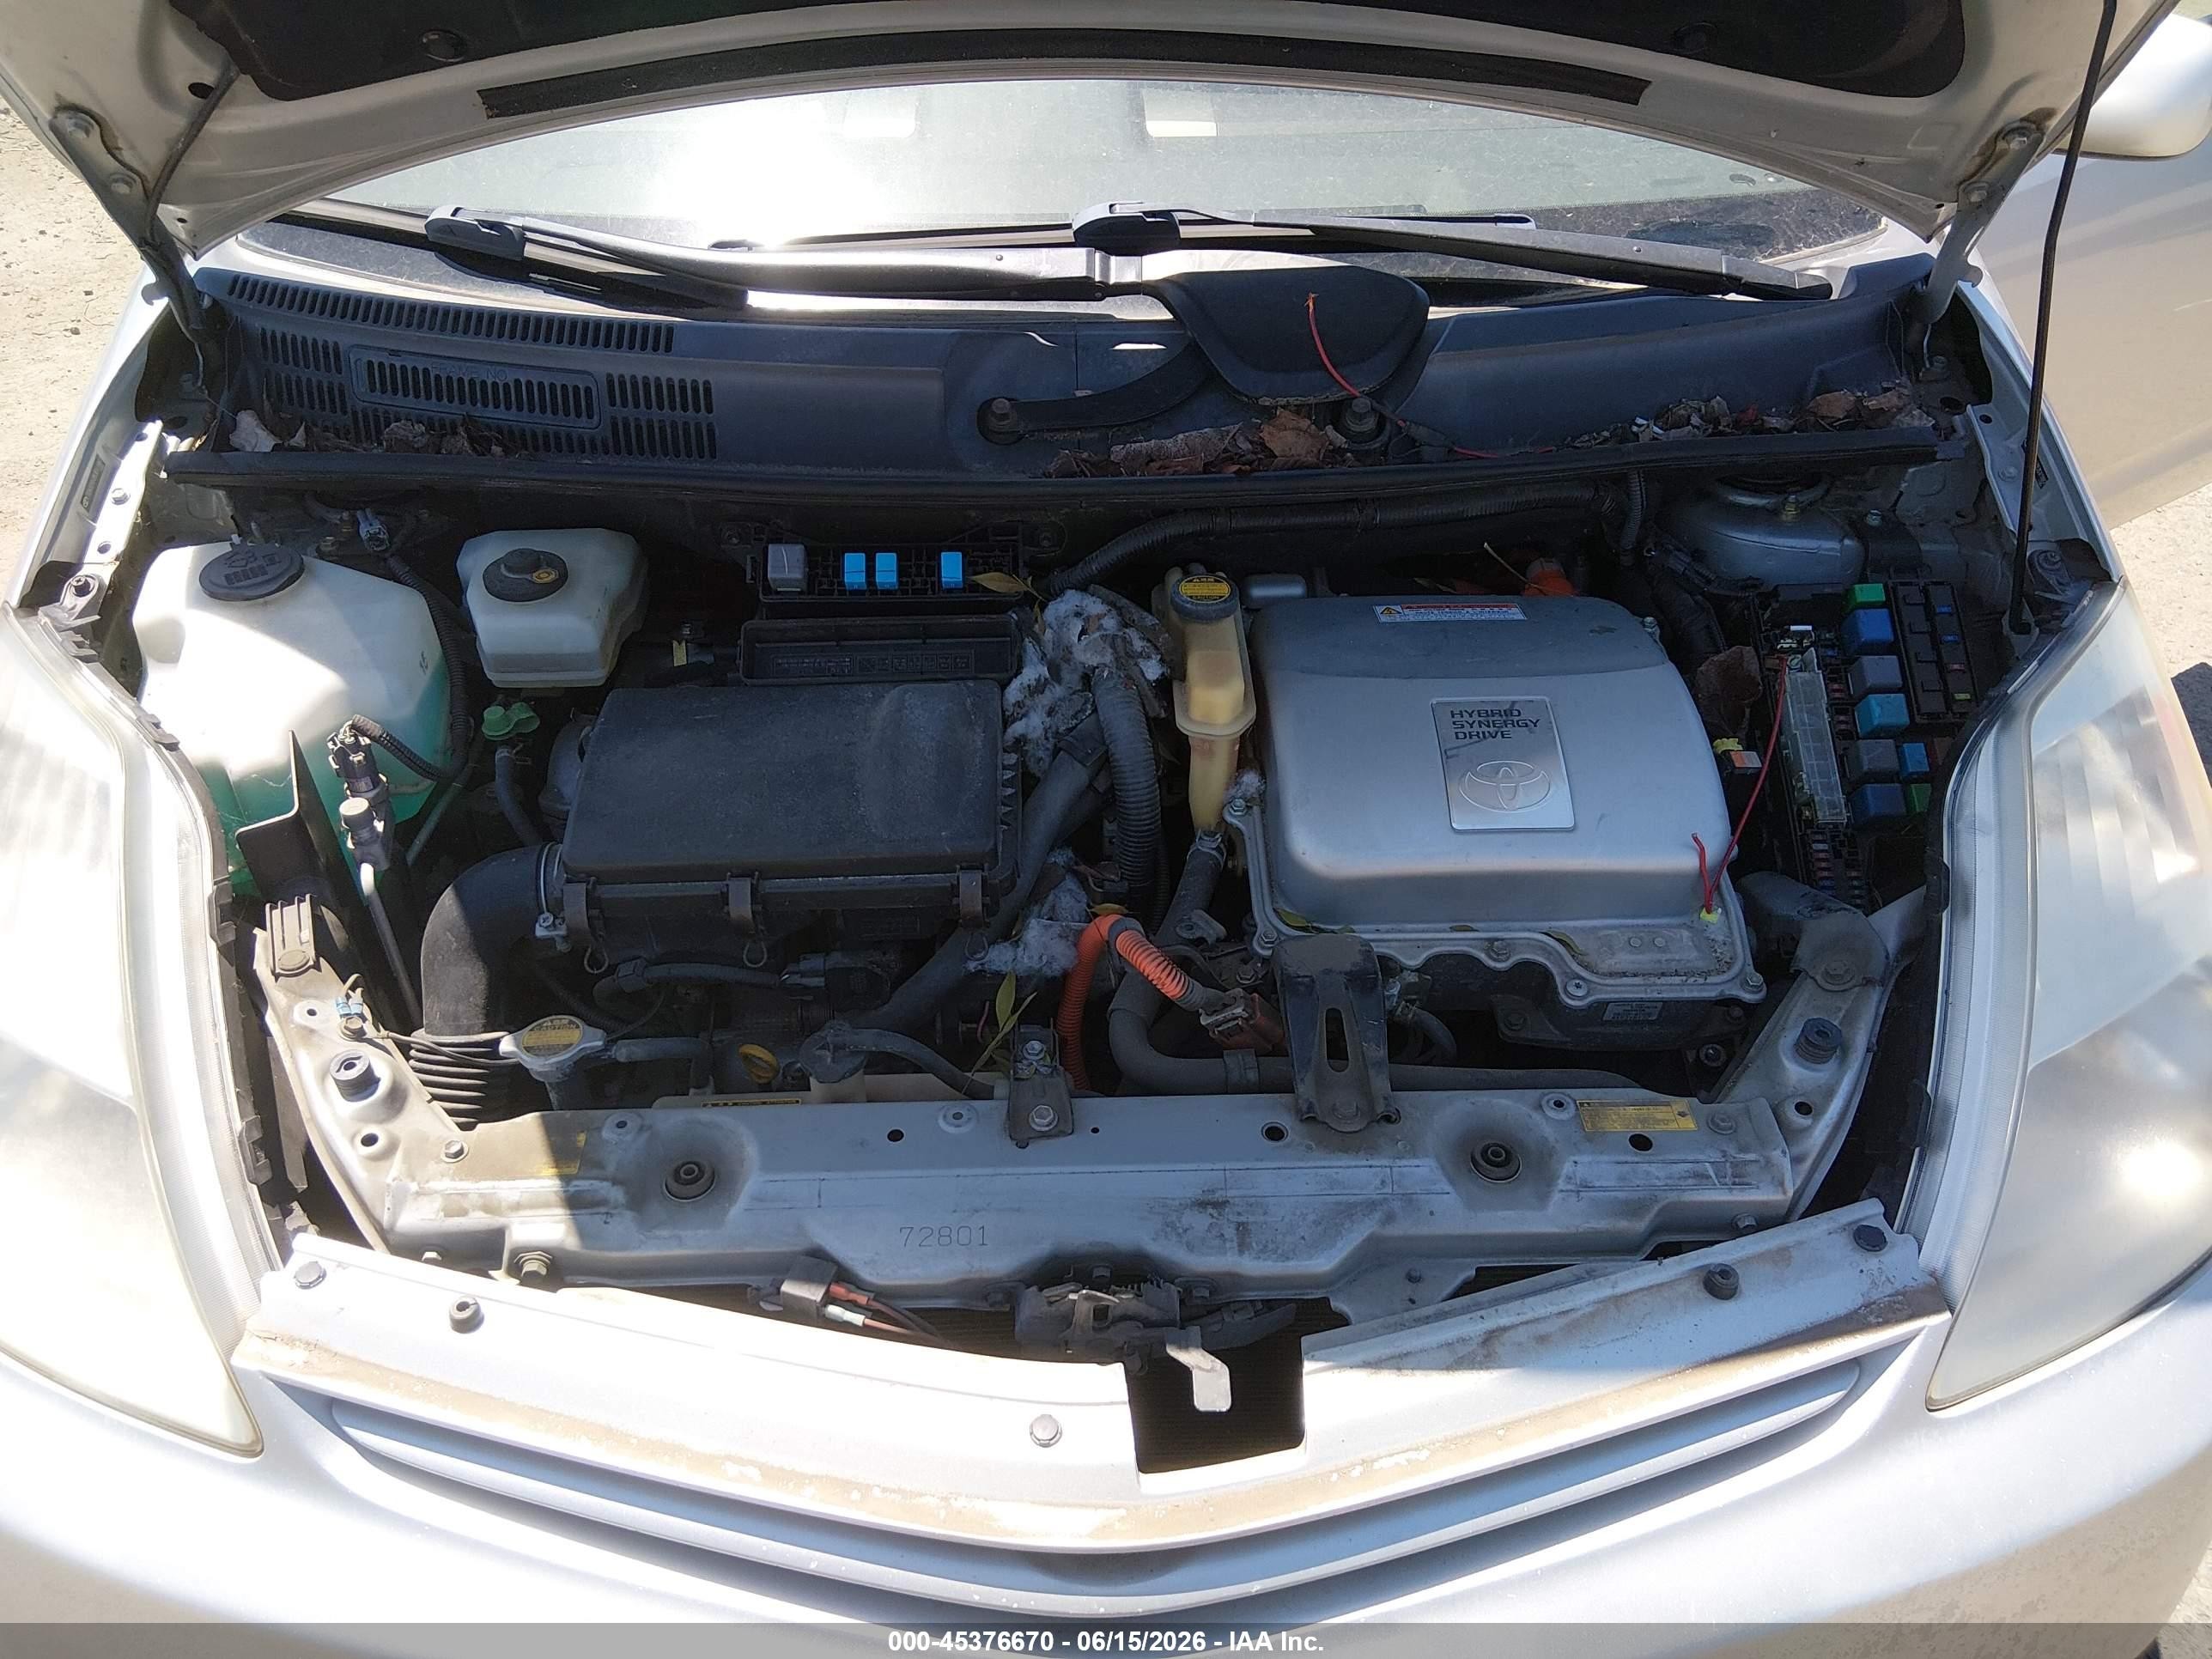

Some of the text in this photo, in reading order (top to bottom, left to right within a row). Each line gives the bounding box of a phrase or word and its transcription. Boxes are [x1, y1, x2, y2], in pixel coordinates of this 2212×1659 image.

[431, 362, 480, 379] FRAME
[1450, 708, 1522, 719] HYBRID
[1452, 719, 1540, 729] SYNERGY
[1455, 730, 1512, 740] DRIVE
[899, 1225, 988, 1247] 72801
